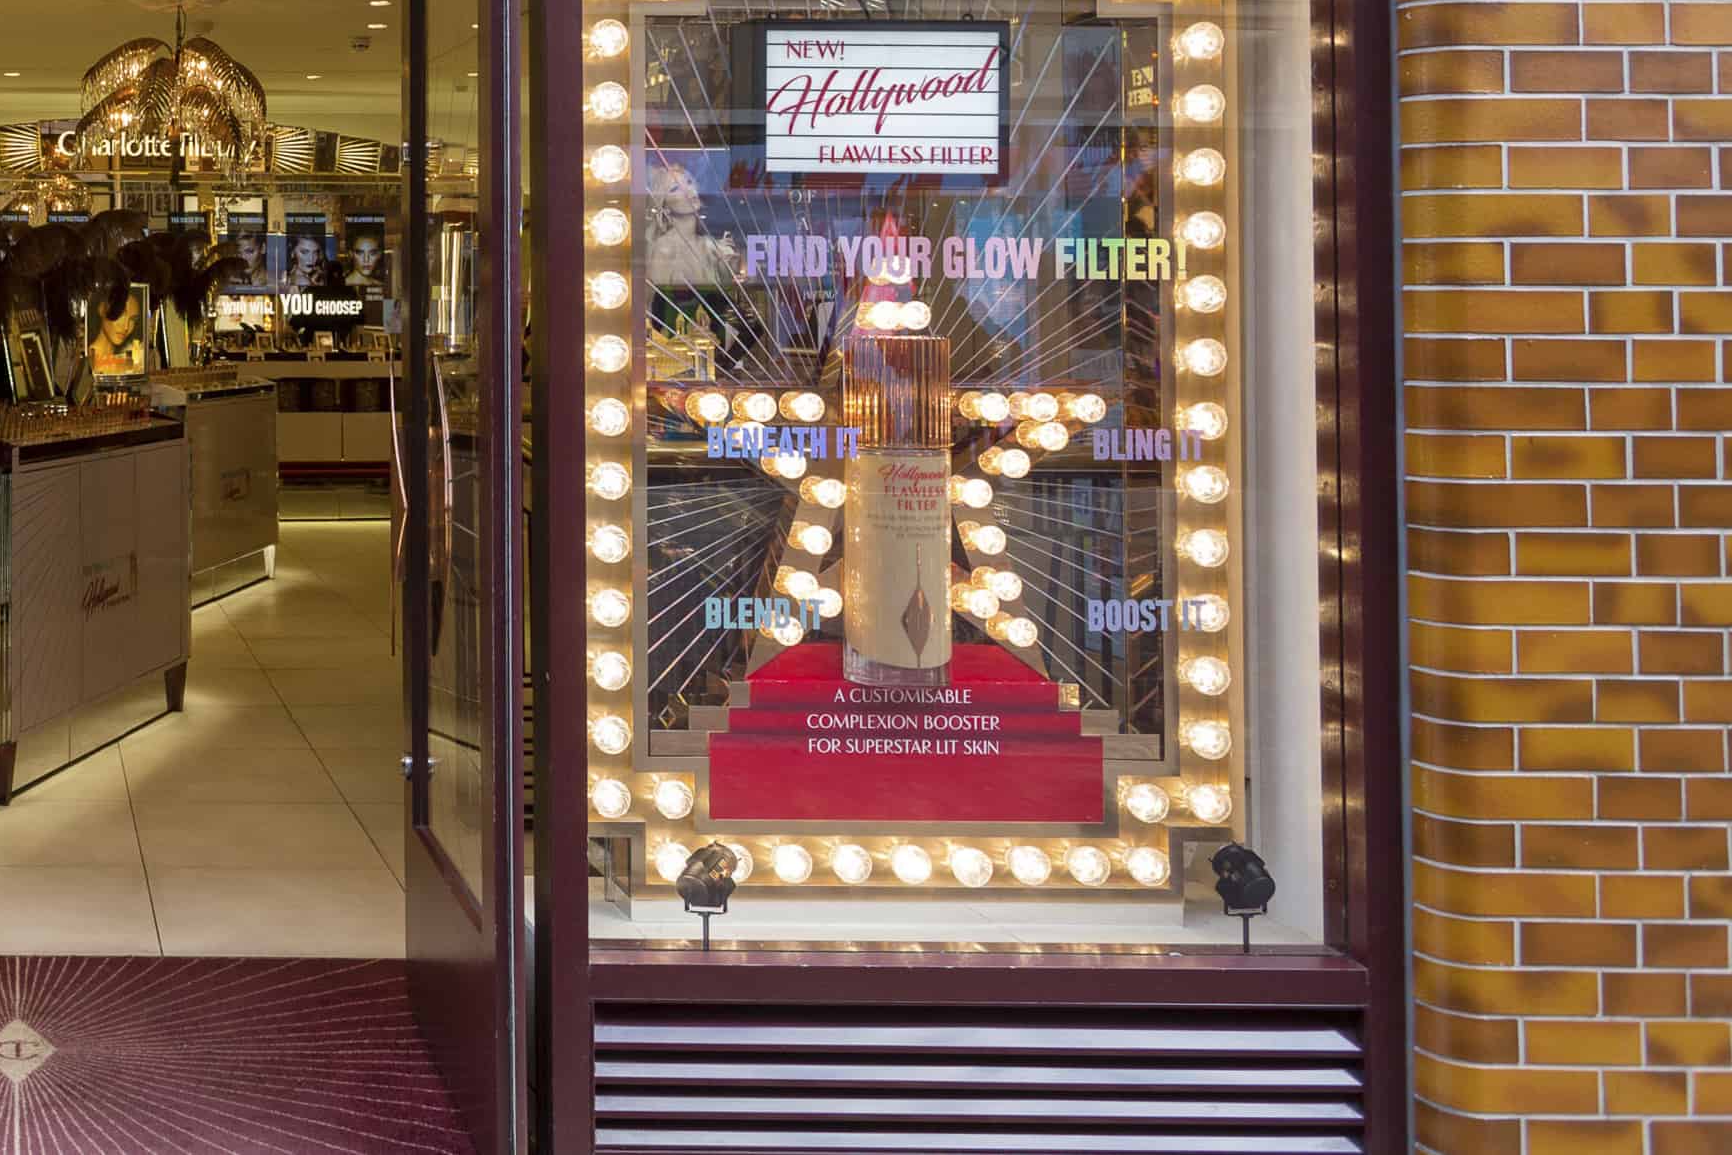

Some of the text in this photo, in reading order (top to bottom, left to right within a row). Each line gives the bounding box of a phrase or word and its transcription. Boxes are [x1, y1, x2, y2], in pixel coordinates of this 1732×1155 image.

[786, 40, 844, 60] NEW!
[766, 46, 1000, 134] Hollywood
[819, 145, 993, 165] FLAWLESS FILTER
[746, 235, 1187, 280] FIND YOUR GLOW FILTER!
[280, 293, 315, 316] YOU
[707, 427, 860, 458] BENEATH IT
[1093, 429, 1205, 462] BLING IT
[897, 499, 938, 511] FILTER
[705, 597, 825, 630] BLEND IT
[1088, 599, 1207, 632] BOOST IT
[834, 688, 972, 704] A CUSTOMISABLE
[806, 713, 1000, 731] COMPLEXION BOOSTER
[808, 738, 1000, 756] FOR SUPERSTAR LIT SKIN
